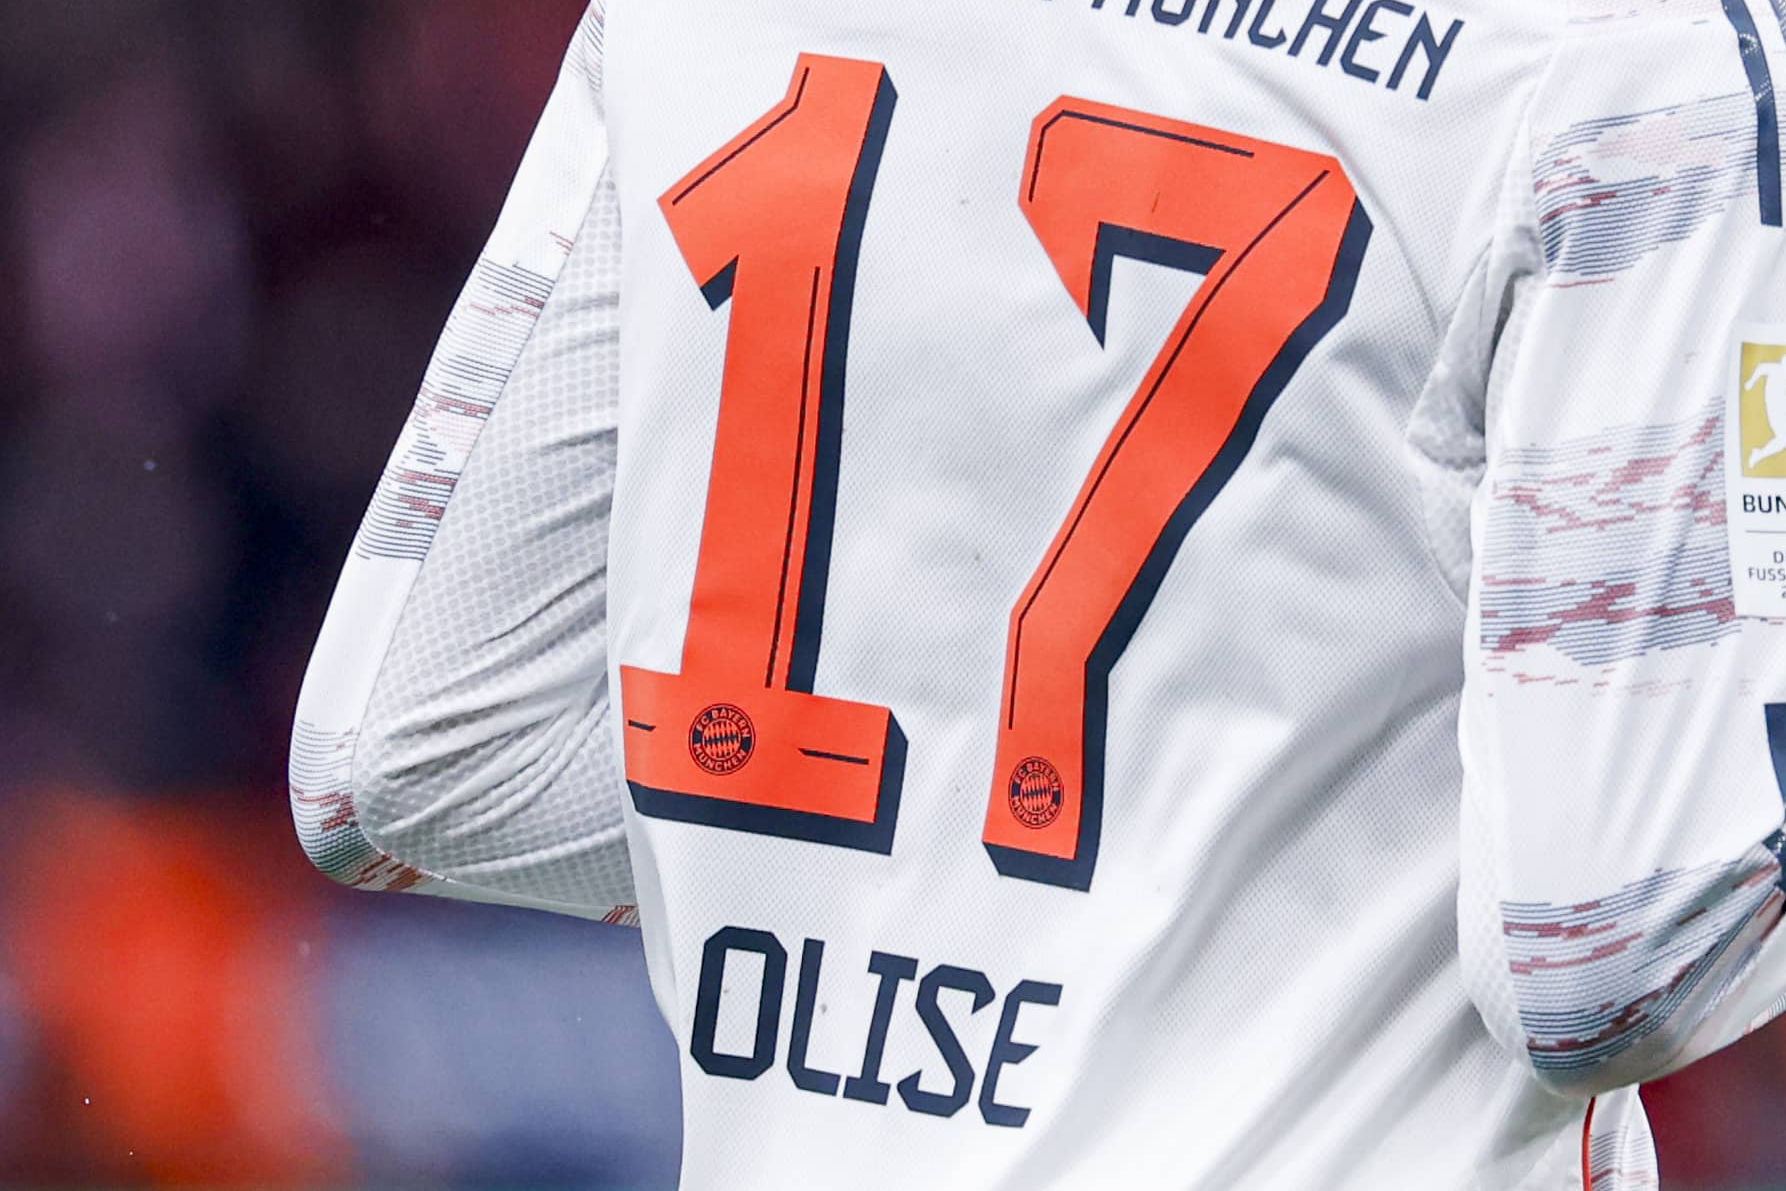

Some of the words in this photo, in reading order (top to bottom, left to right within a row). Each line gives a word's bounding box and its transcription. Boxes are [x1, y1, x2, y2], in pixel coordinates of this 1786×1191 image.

[620, 52, 1375, 893] 17
[711, 707, 751, 738] BAYERN
[690, 925, 1064, 1129] OLISE
